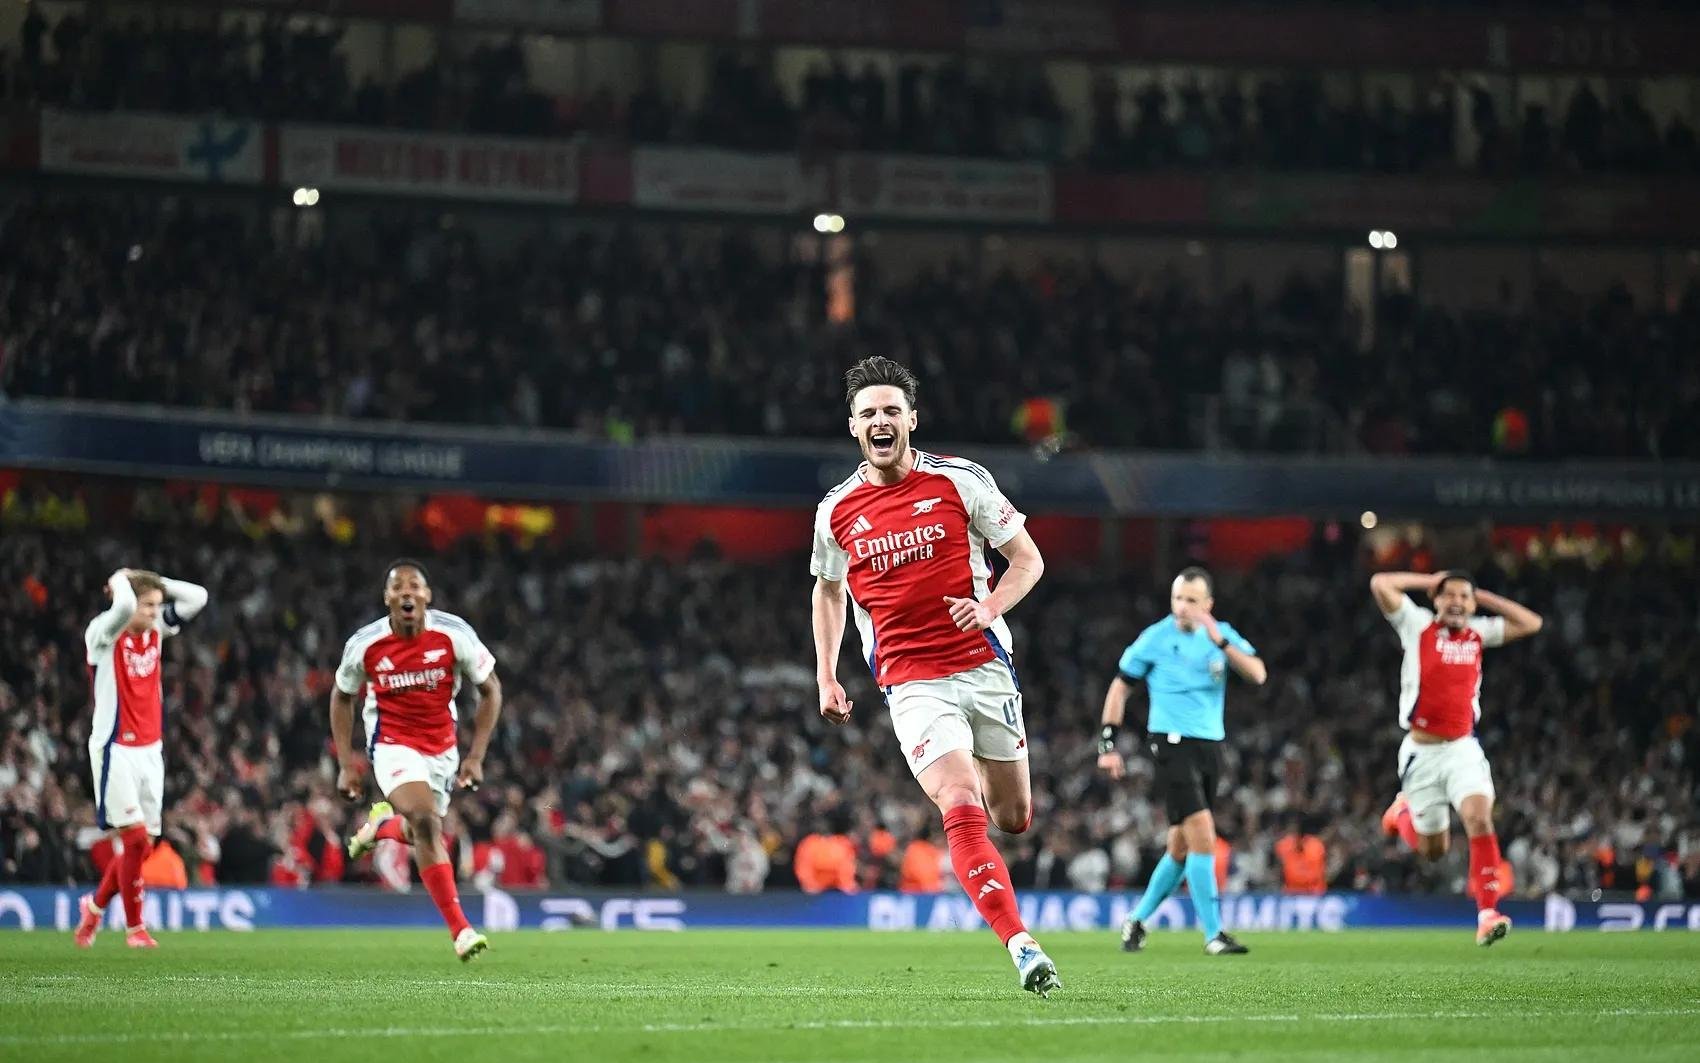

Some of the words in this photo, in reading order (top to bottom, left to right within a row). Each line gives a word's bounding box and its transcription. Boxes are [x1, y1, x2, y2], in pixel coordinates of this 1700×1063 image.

[853, 523, 946, 559] Emirates
[872, 554, 888, 572] FLY
[893, 543, 933, 567] BETTER
[968, 862, 996, 879] AFC
